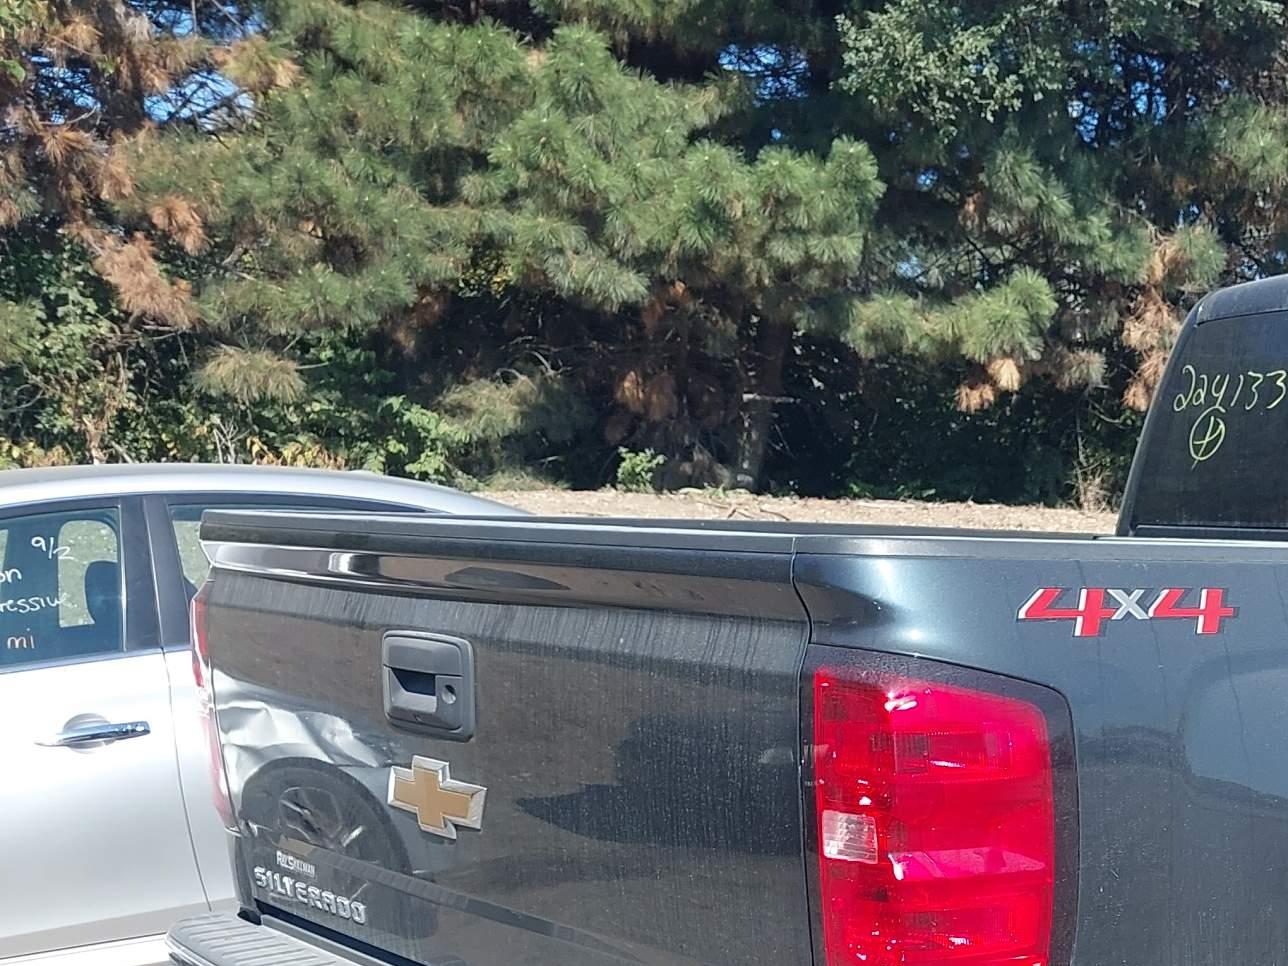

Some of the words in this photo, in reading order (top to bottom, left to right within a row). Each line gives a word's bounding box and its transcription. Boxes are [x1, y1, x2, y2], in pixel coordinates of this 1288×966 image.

[1173, 364, 1287, 412] 224133
[7, 628, 35, 649] mi
[254, 866, 367, 925] SILVERADO
